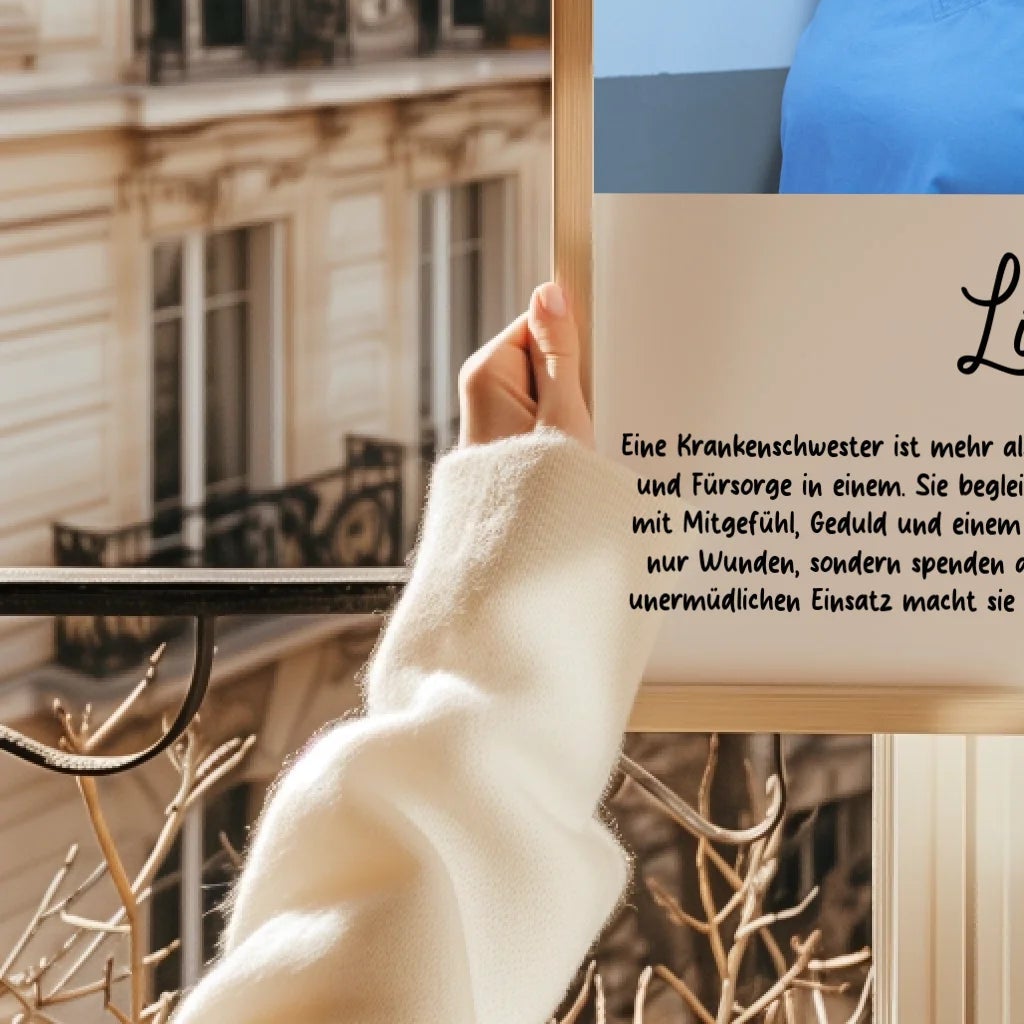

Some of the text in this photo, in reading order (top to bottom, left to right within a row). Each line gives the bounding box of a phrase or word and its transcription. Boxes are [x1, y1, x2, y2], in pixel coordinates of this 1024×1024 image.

[621, 432, 667, 459] Eine
[677, 432, 885, 459] Krankenschwester
[893, 433, 921, 458] ist
[930, 433, 994, 459] mehr
[637, 471, 682, 498] und
[691, 471, 793, 501] Fürsorge
[802, 472, 823, 498] in
[832, 472, 906, 498] einem.
[915, 472, 949, 498] Sie
[632, 509, 673, 535] mit
[683, 510, 800, 540] Mitgefühl,
[810, 510, 888, 537] Geduld
[897, 510, 942, 537] und
[952, 511, 1021, 537] einem
[647, 554, 690, 575] nur
[698, 549, 800, 579] Wunden,
[809, 549, 901, 576] sondern
[911, 550, 1005, 580] spenden
[629, 587, 801, 614] unermüdlichen
[811, 587, 893, 613] Einsatz
[902, 588, 978, 613] macht
[987, 588, 1016, 613] sie
